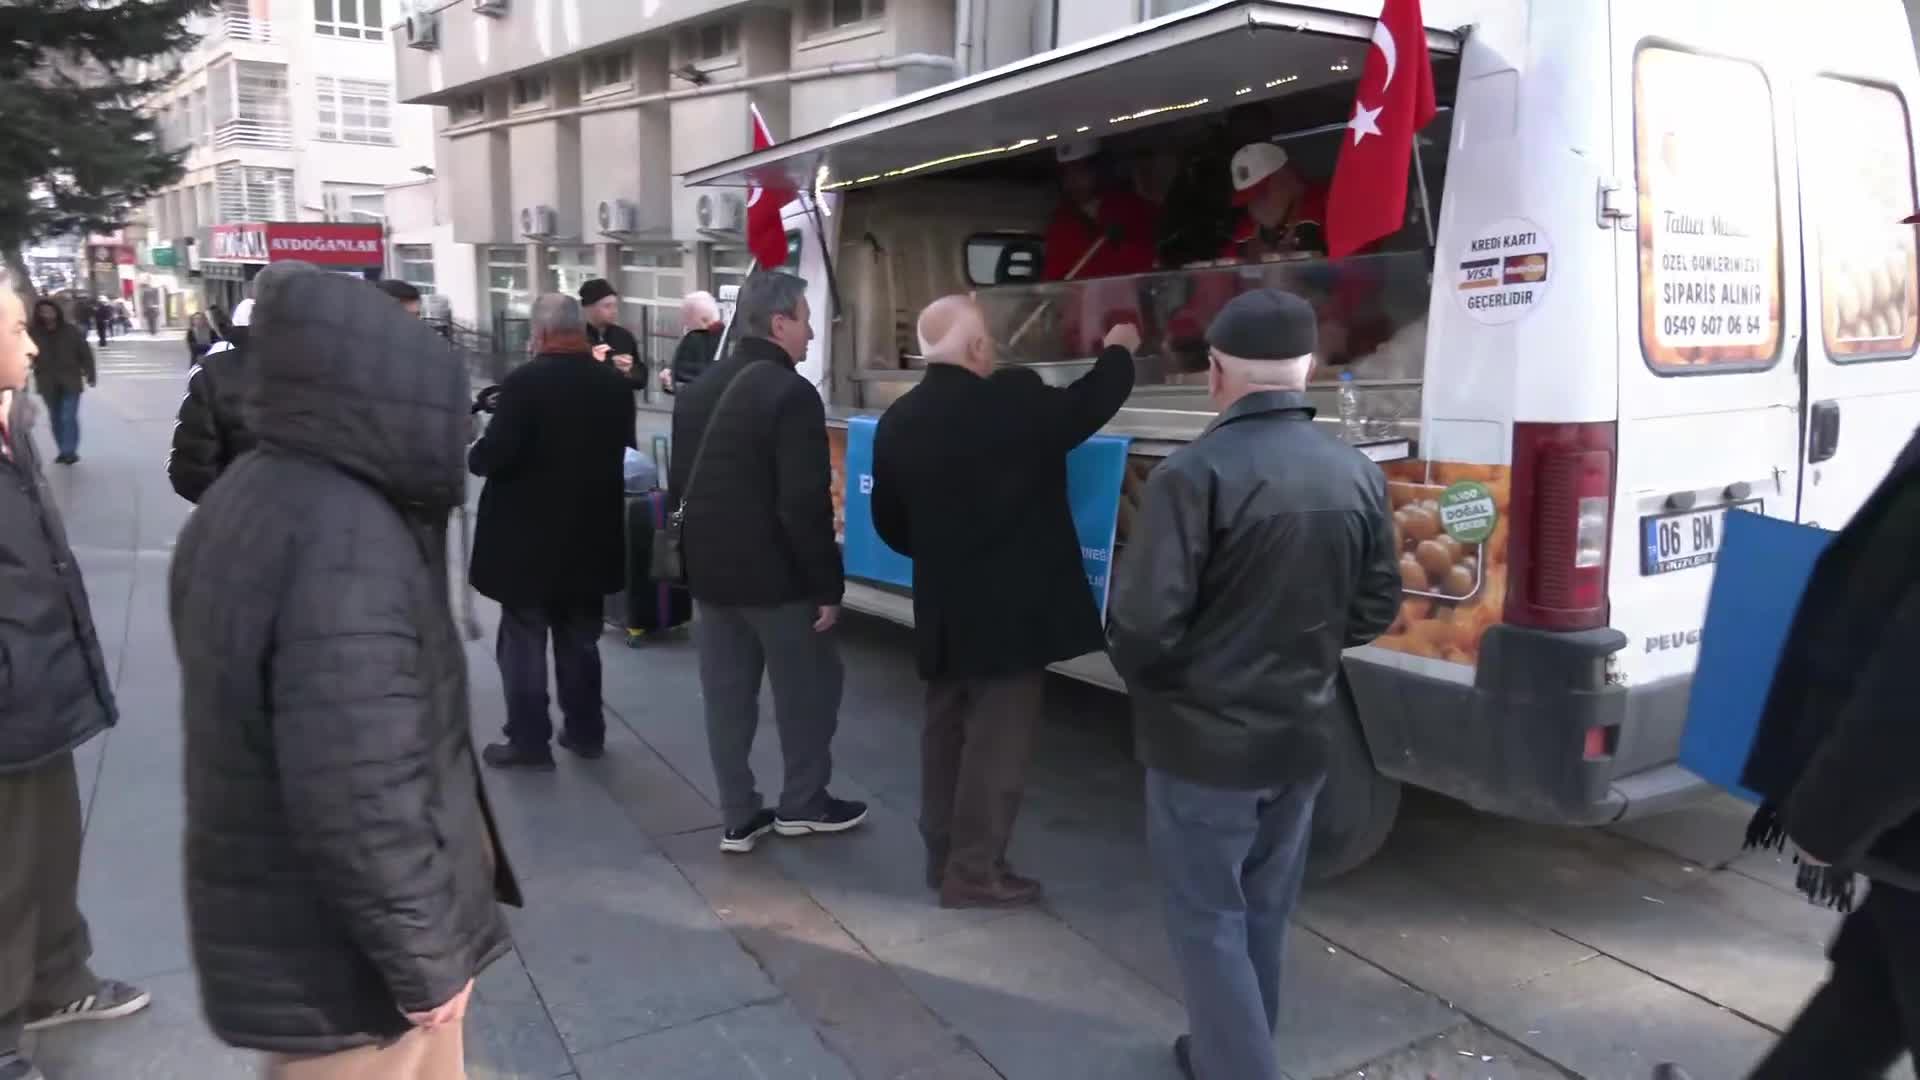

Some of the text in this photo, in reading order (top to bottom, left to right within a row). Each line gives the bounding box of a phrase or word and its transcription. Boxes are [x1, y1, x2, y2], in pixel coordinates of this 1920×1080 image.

[1471, 232, 1536, 252] KREDİ KARTI
[1466, 267, 1493, 280] VISA
[1467, 290, 1533, 311] GEÇERLİDİR
[1664, 315, 1760, 336] 0549 607 06 64
[1445, 502, 1489, 520] DOĞAL
[1659, 514, 1714, 558] 06 BM
[1645, 629, 1702, 655] PEUG
